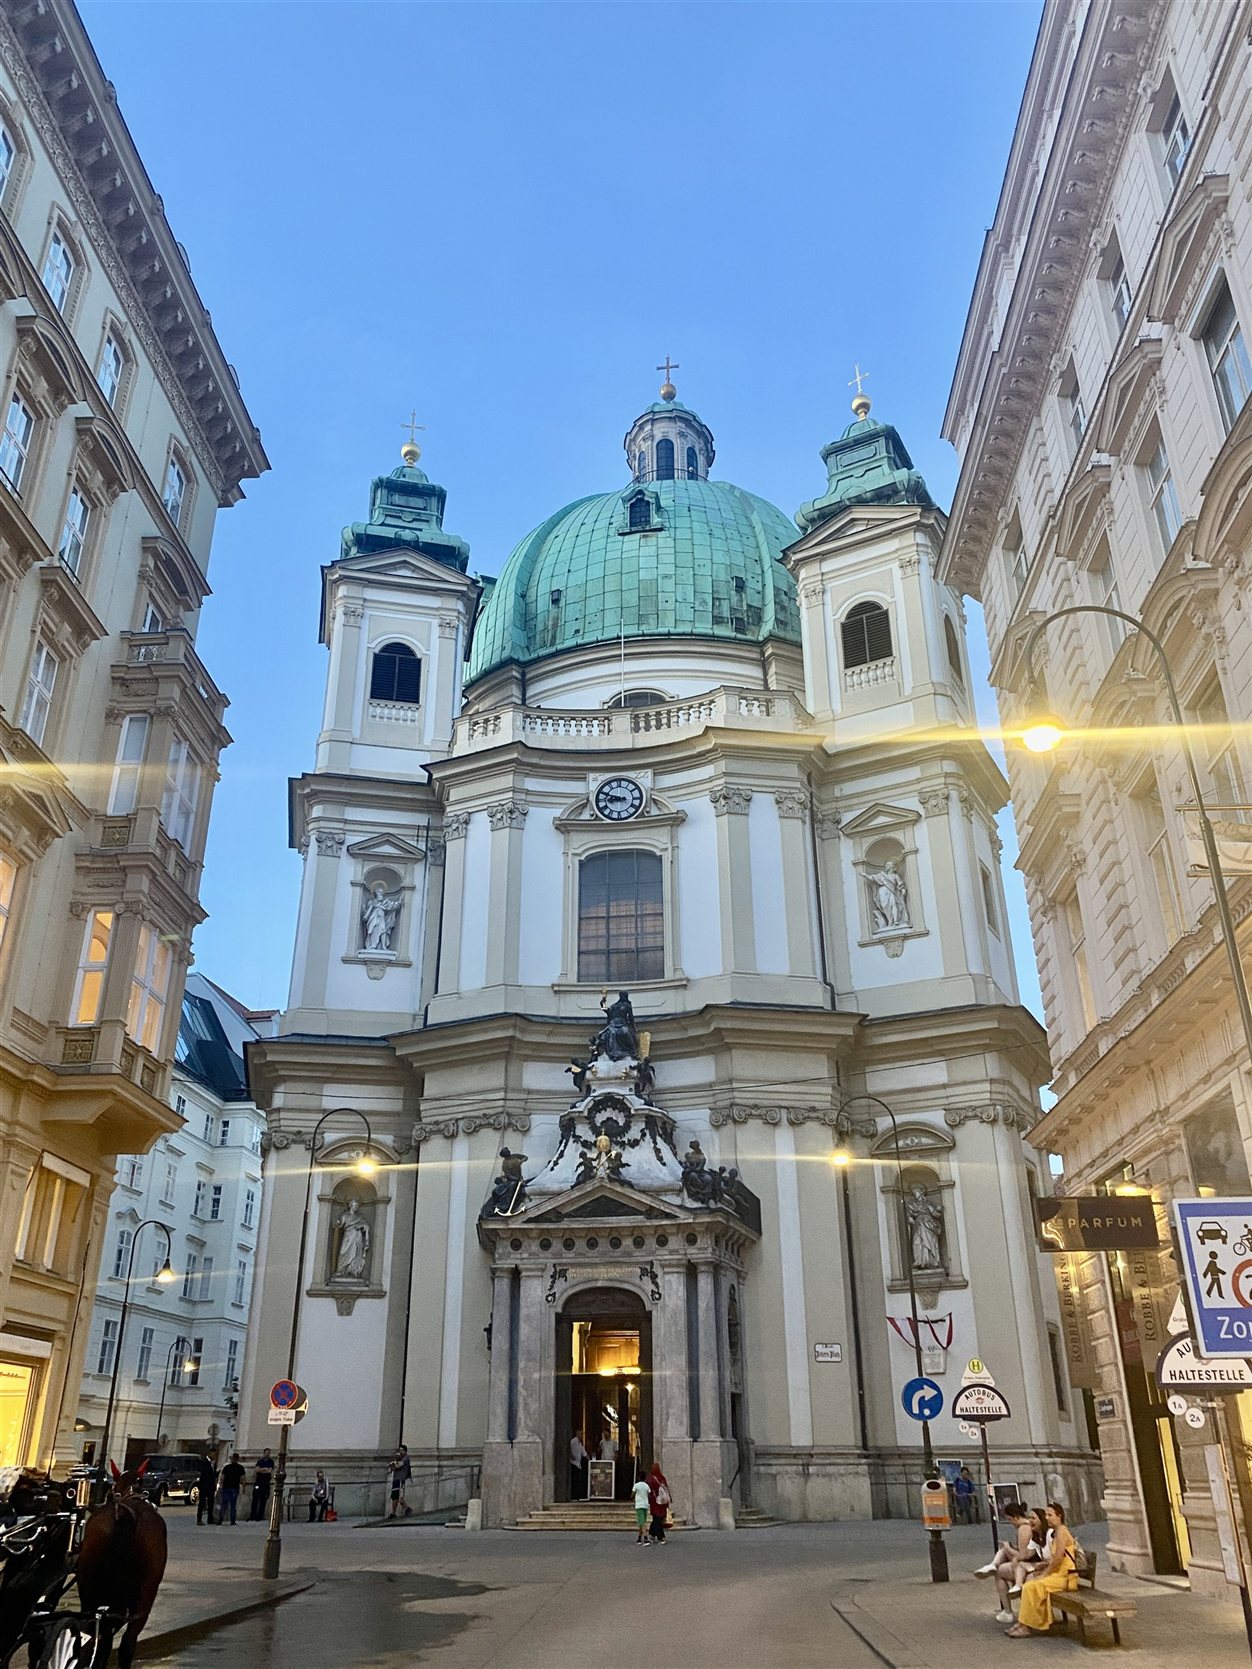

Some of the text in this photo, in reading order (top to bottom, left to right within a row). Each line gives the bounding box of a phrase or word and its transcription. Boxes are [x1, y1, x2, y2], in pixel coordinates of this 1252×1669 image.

[1068, 1217, 1143, 1229] PARFUM
[1137, 1279, 1147, 1288] &
[1141, 1293, 1156, 1341] ROBBE
[1216, 1316, 1252, 1339] Zo
[972, 1361, 980, 1371] H
[1169, 1369, 1245, 1381] HALTESTELLE
[964, 1388, 996, 1401] AUTOBUS
[959, 1406, 1003, 1414] HALTESTELLE
[1172, 1400, 1183, 1410] 1A
[1189, 1413, 1201, 1423] 2A
